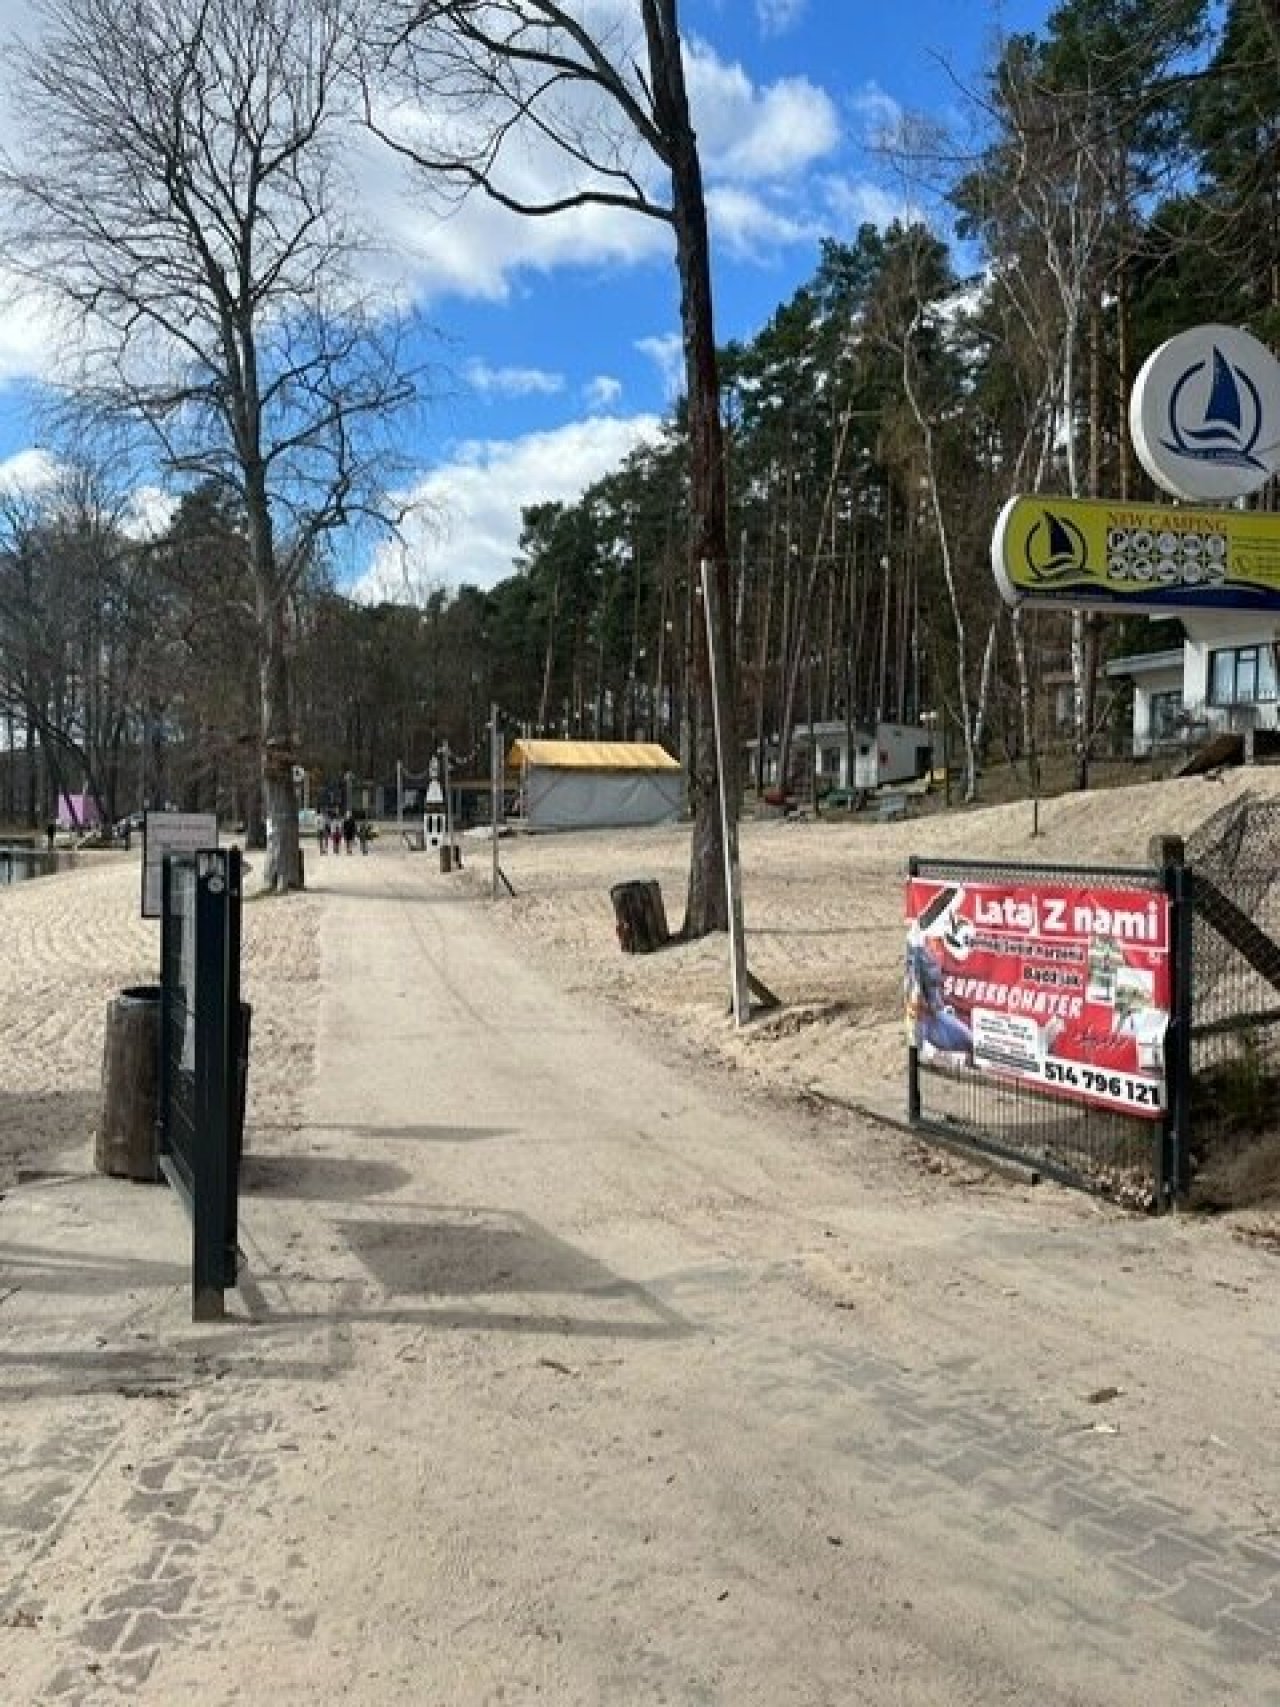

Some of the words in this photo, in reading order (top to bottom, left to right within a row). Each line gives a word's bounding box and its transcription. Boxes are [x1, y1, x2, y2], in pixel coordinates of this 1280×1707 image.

[1151, 514, 1228, 532] CAMPING
[974, 893, 1038, 937] Lataj
[1042, 899, 1068, 932] Z
[1074, 900, 1158, 940] nami
[1044, 1061, 1079, 1086] 514
[1082, 1068, 1121, 1098] 796
[1124, 1079, 1162, 1106] 121
